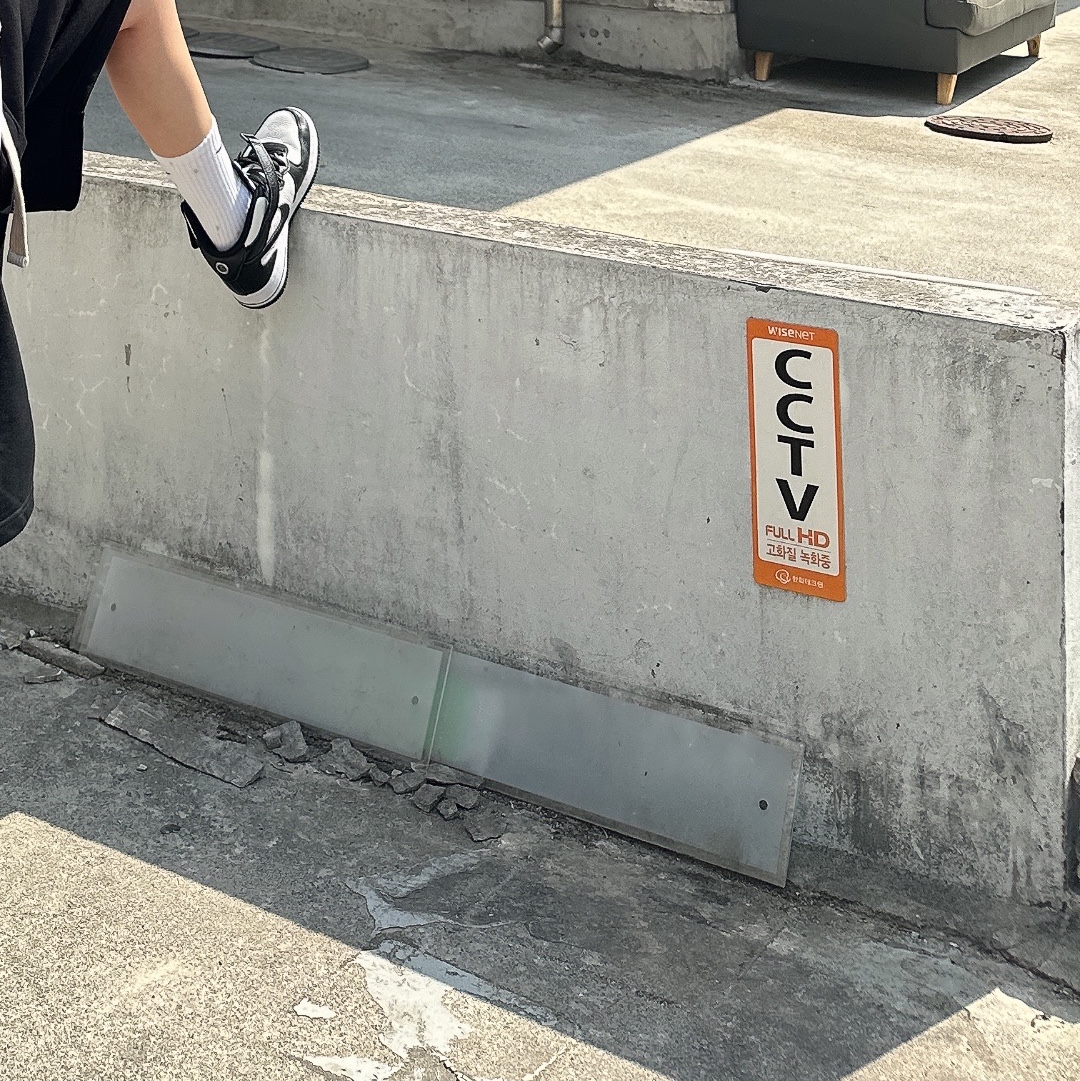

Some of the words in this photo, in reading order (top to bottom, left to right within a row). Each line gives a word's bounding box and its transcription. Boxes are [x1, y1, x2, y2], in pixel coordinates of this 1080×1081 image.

[774, 348, 819, 522] CCTV
[765, 525, 795, 541] FULL
[797, 527, 831, 549] HD
[766, 543, 797, 563] 고화질
[800, 549, 832, 570] 녹화중
